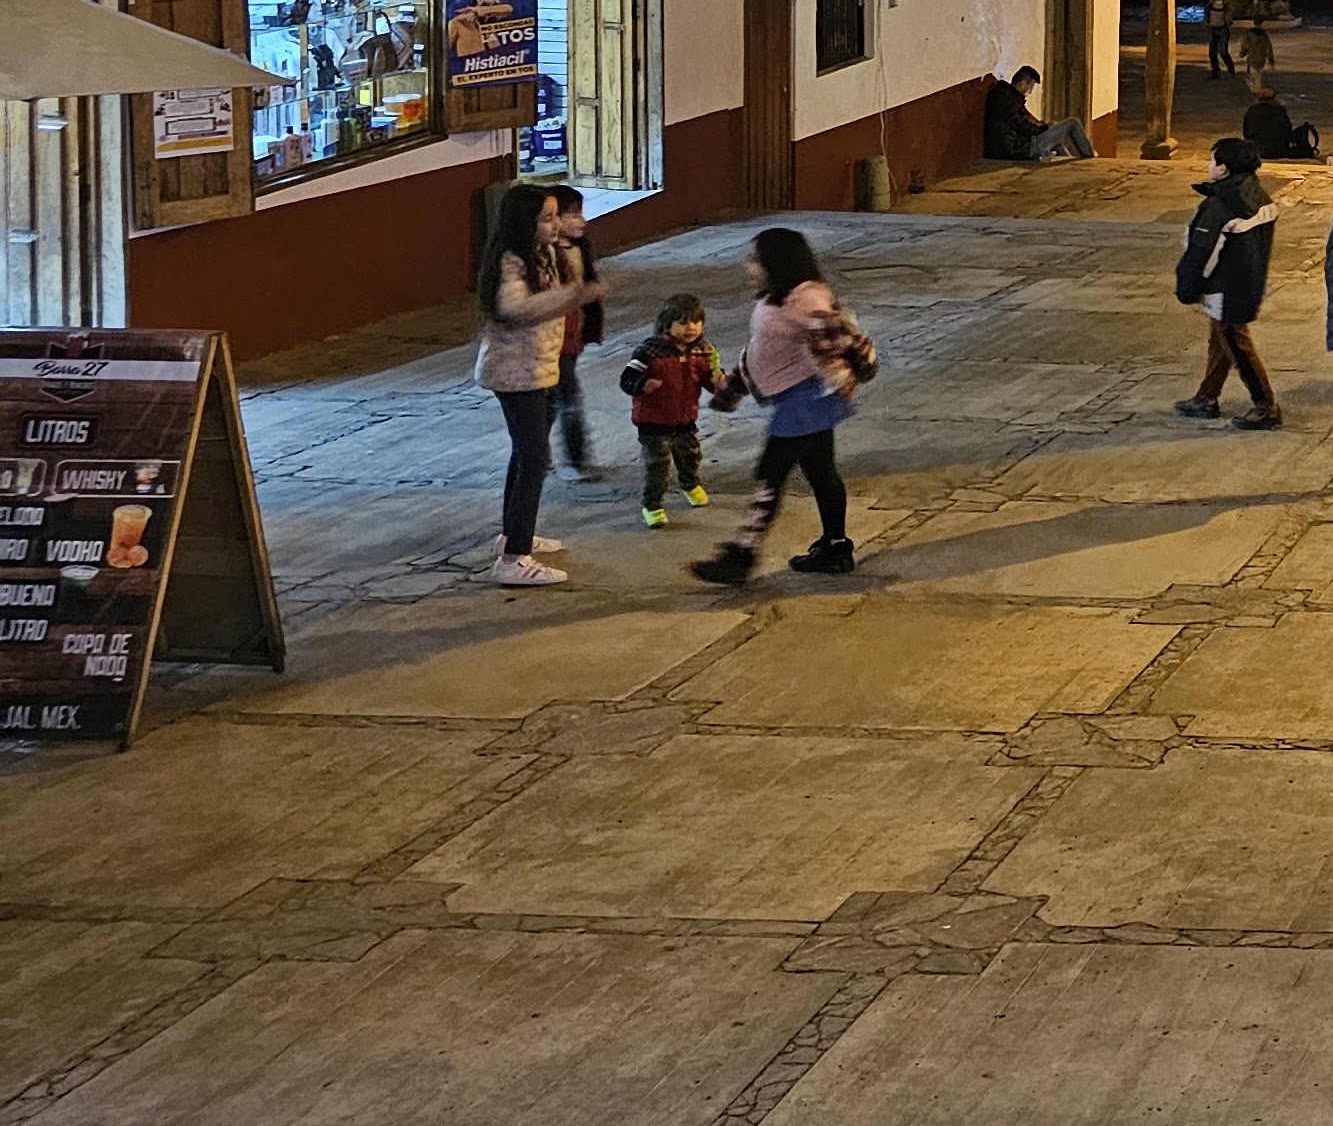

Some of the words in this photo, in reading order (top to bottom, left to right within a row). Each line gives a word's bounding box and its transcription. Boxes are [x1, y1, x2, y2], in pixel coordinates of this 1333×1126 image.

[464, 49, 525, 72] Histiacil
[469, 70, 504, 80] EXPERTO
[82, 361, 109, 376] 27
[25, 419, 91, 443] LITROS
[108, 633, 133, 654] DE
